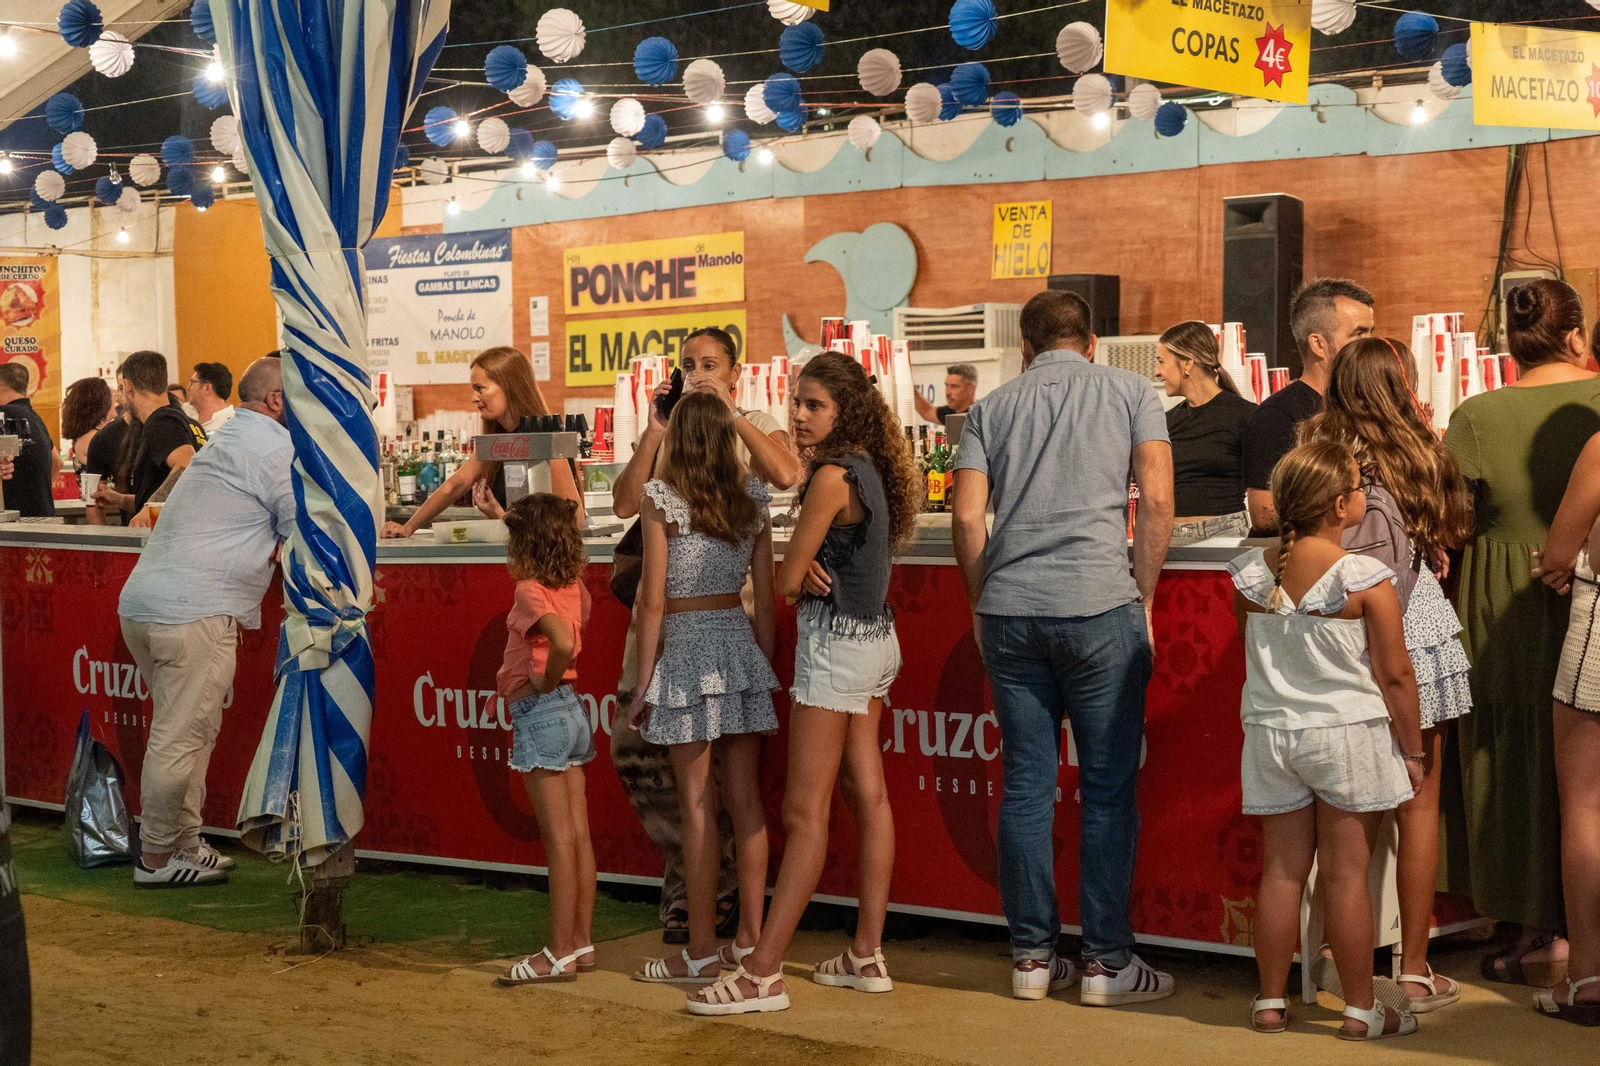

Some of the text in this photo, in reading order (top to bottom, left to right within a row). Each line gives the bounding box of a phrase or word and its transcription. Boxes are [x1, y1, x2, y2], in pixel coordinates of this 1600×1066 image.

[1192, 0, 1265, 22] MACETAZO
[1171, 27, 1240, 64] COPAS
[1261, 38, 1286, 70] 4€
[1513, 46, 1585, 63] EL MACETAZO
[1491, 75, 1580, 103] MACETAZO
[998, 205, 1048, 222] VENTA
[1013, 223, 1032, 239] DE
[388, 240, 507, 268] Fiestas Colombinas
[695, 243, 705, 254] de
[566, 254, 581, 266] Hay
[698, 251, 743, 268] Manolo
[993, 241, 1049, 276] HIELO
[0, 265, 47, 273] INCHITOS
[444, 270, 461, 278] PLATO
[367, 275, 388, 285] INAS
[418, 278, 496, 292] GAMBAS BLANCAS
[571, 256, 697, 307] PONCHE
[437, 309, 476, 323] Ponche de
[4, 337, 36, 347] QUESO
[371, 337, 399, 347] FRITAS
[430, 326, 485, 341] MANOLO
[416, 348, 483, 364] EL MACET
[569, 334, 592, 373] EL
[104, 711, 147, 728] DESDE
[919, 775, 994, 797] DESDE
